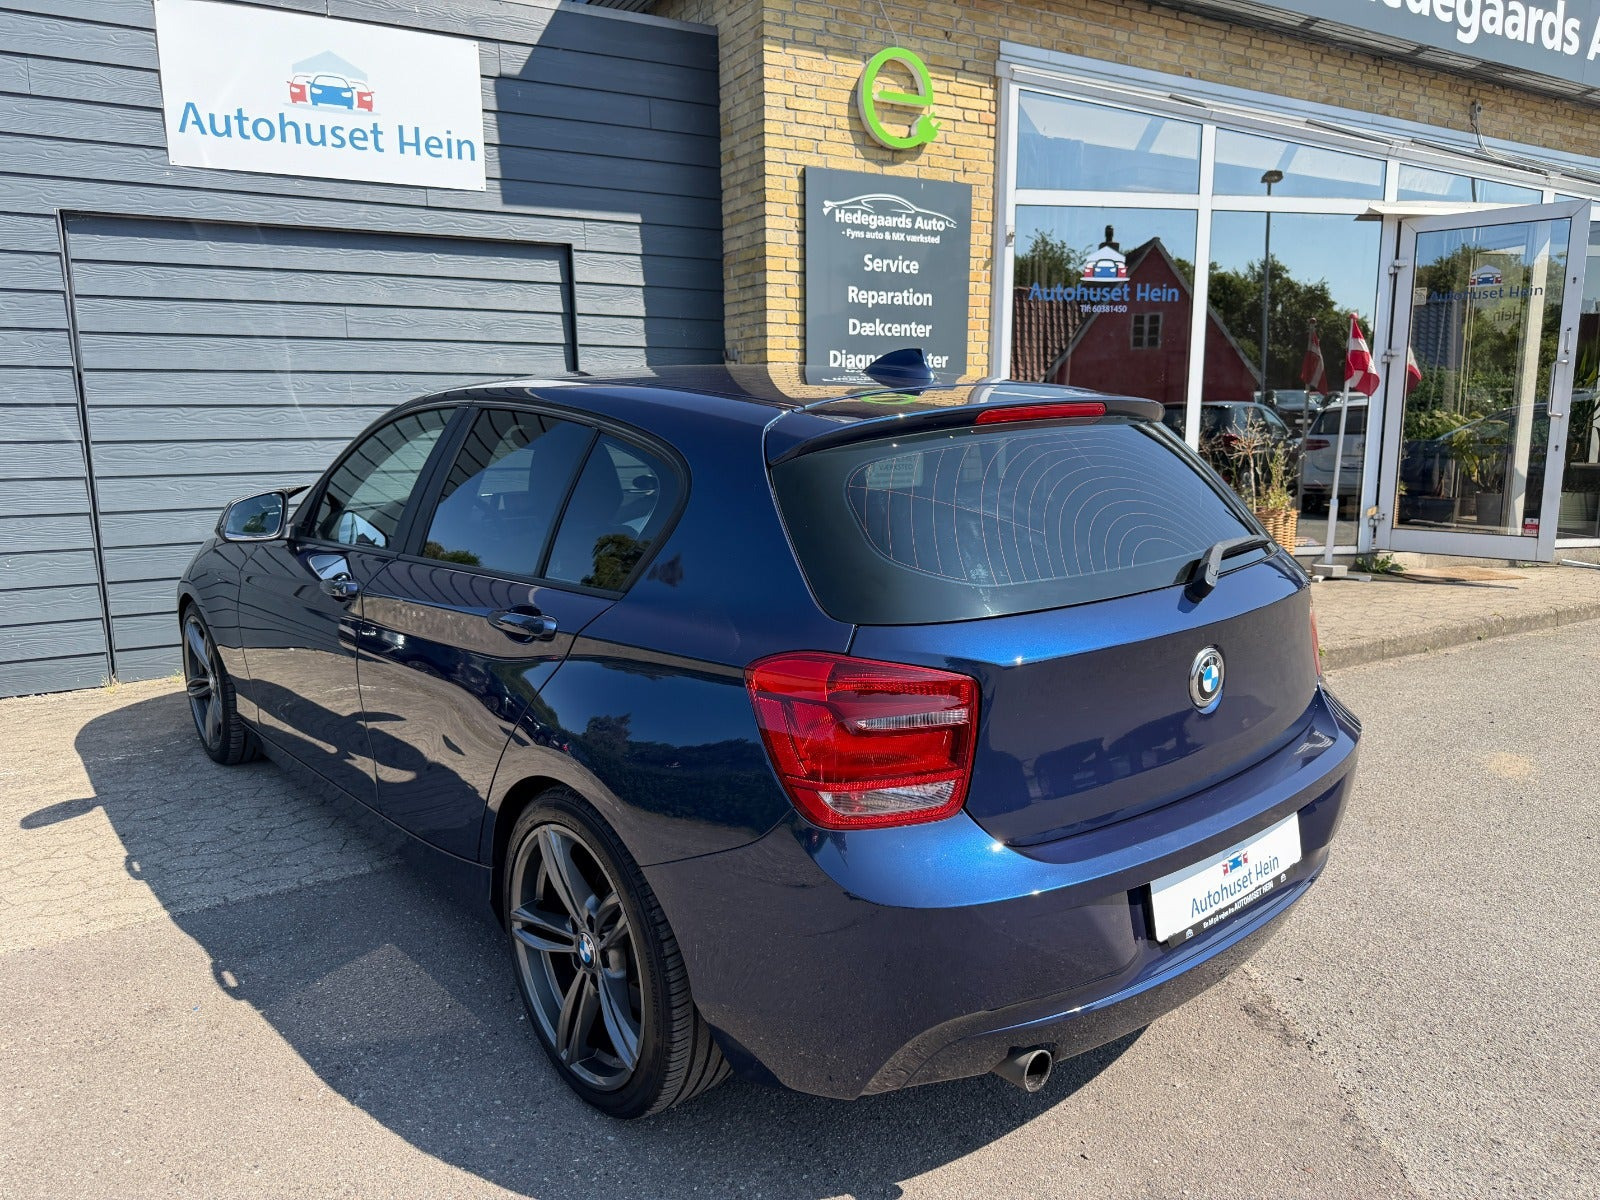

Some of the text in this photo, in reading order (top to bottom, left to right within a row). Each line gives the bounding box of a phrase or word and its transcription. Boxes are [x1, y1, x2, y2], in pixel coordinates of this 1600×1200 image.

[178, 101, 476, 162] Autohuset Hein
[835, 208, 946, 232] Hedegaards Auto
[846, 228, 865, 239] Fyns
[865, 229, 884, 240] auto
[884, 231, 891, 240] &
[891, 232, 906, 241] MX
[906, 233, 941, 244] værksted
[863, 253, 920, 274] Service
[847, 285, 933, 308] Reparation
[1028, 281, 1180, 302] Autohuset Hein
[1429, 284, 1544, 301] Autohuset Hein
[1092, 304, 1128, 313] 60381450
[848, 318, 933, 338] Dækcenter
[1191, 855, 1280, 919] Autohuset Hein
[1234, 888, 1262, 911] AUTOHUSET
[1262, 880, 1274, 894] HEIN
